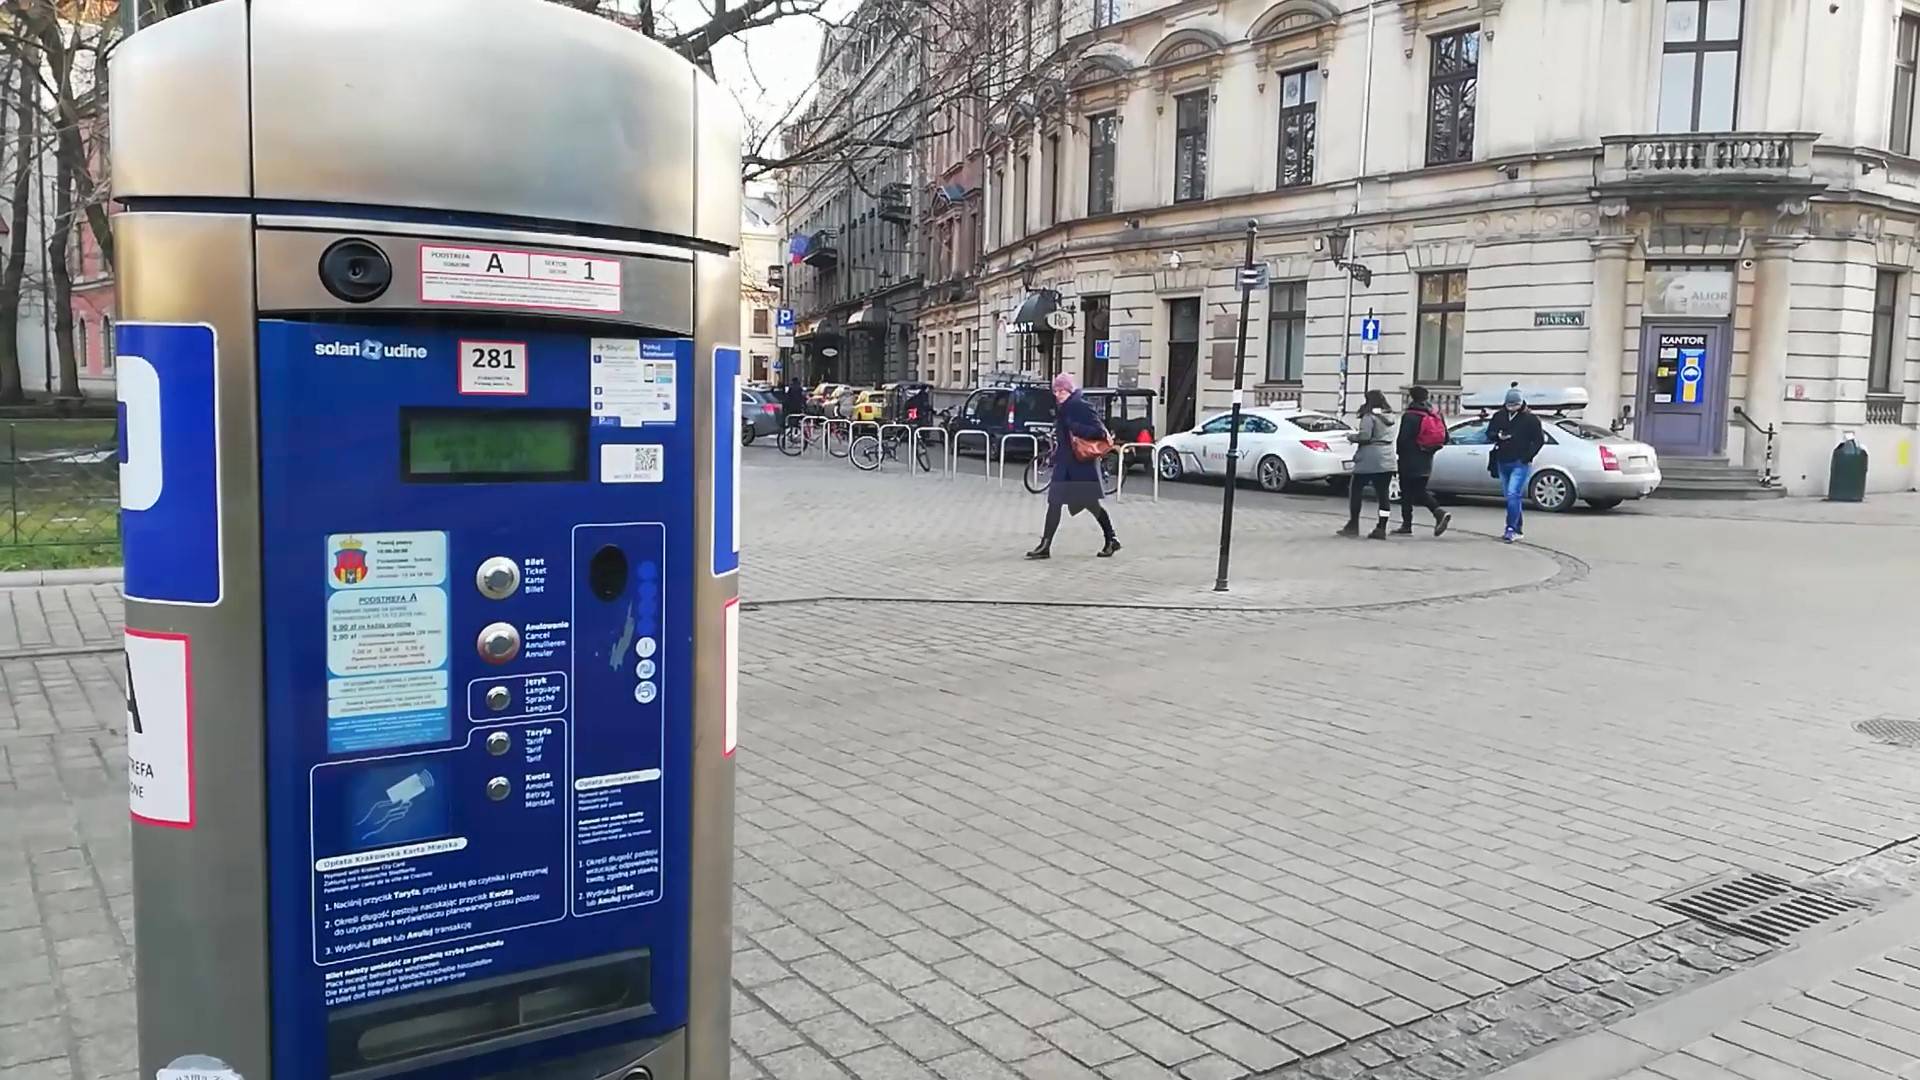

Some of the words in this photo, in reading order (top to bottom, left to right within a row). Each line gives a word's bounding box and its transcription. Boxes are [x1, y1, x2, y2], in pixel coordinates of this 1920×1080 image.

[486, 253, 504, 273] A
[583, 261, 595, 280] 1
[1691, 291, 1728, 301] ALIOR
[780, 310, 791, 325] P
[1661, 336, 1704, 345] KANTOR
[315, 341, 360, 357] solari
[384, 343, 427, 359] udine
[472, 348, 516, 368] 281
[525, 558, 544, 566] Bilet
[525, 632, 550, 640] Cancel
[525, 650, 553, 658] Annuler
[525, 685, 561, 695] Language
[525, 695, 555, 705] Sprache
[525, 704, 552, 713] Langue
[526, 727, 552, 737] Taryfa
[526, 772, 551, 781] Kwota
[526, 781, 554, 790] Amount
[526, 790, 550, 800] Betrag
[526, 799, 555, 808] Montant
[324, 859, 353, 868] Opłata
[355, 851, 400, 862] Krakowska
[403, 847, 425, 855] Karta
[427, 842, 458, 851] Miejska
[325, 903, 332, 912] 1.
[363, 893, 393, 906] przycisk
[449, 881, 466, 891] kartę
[468, 879, 477, 887] do
[478, 874, 506, 886] czytnika
[510, 868, 548, 881] przytrzymaj
[325, 921, 333, 929] 2.
[391, 905, 419, 918] postoju
[420, 898, 458, 913] naciskając
[459, 892, 487, 906] przycisk
[489, 888, 513, 899] Kwota
[334, 928, 345, 937] do
[346, 920, 384, 935] uzyskania
[385, 919, 394, 927] na
[446, 902, 493, 917] planowanego
[494, 898, 514, 908] czasu
[515, 893, 540, 905] postoju
[326, 947, 333, 955] 3.
[334, 939, 372, 954] Wydrukuj
[372, 935, 393, 946] Bilet
[394, 933, 406, 942] lub
[407, 927, 434, 940] Anuluj
[435, 921, 472, 935] transakcję
[326, 971, 344, 980] Bilet
[326, 979, 344, 988] Place
[369, 969, 391, 978] behind
